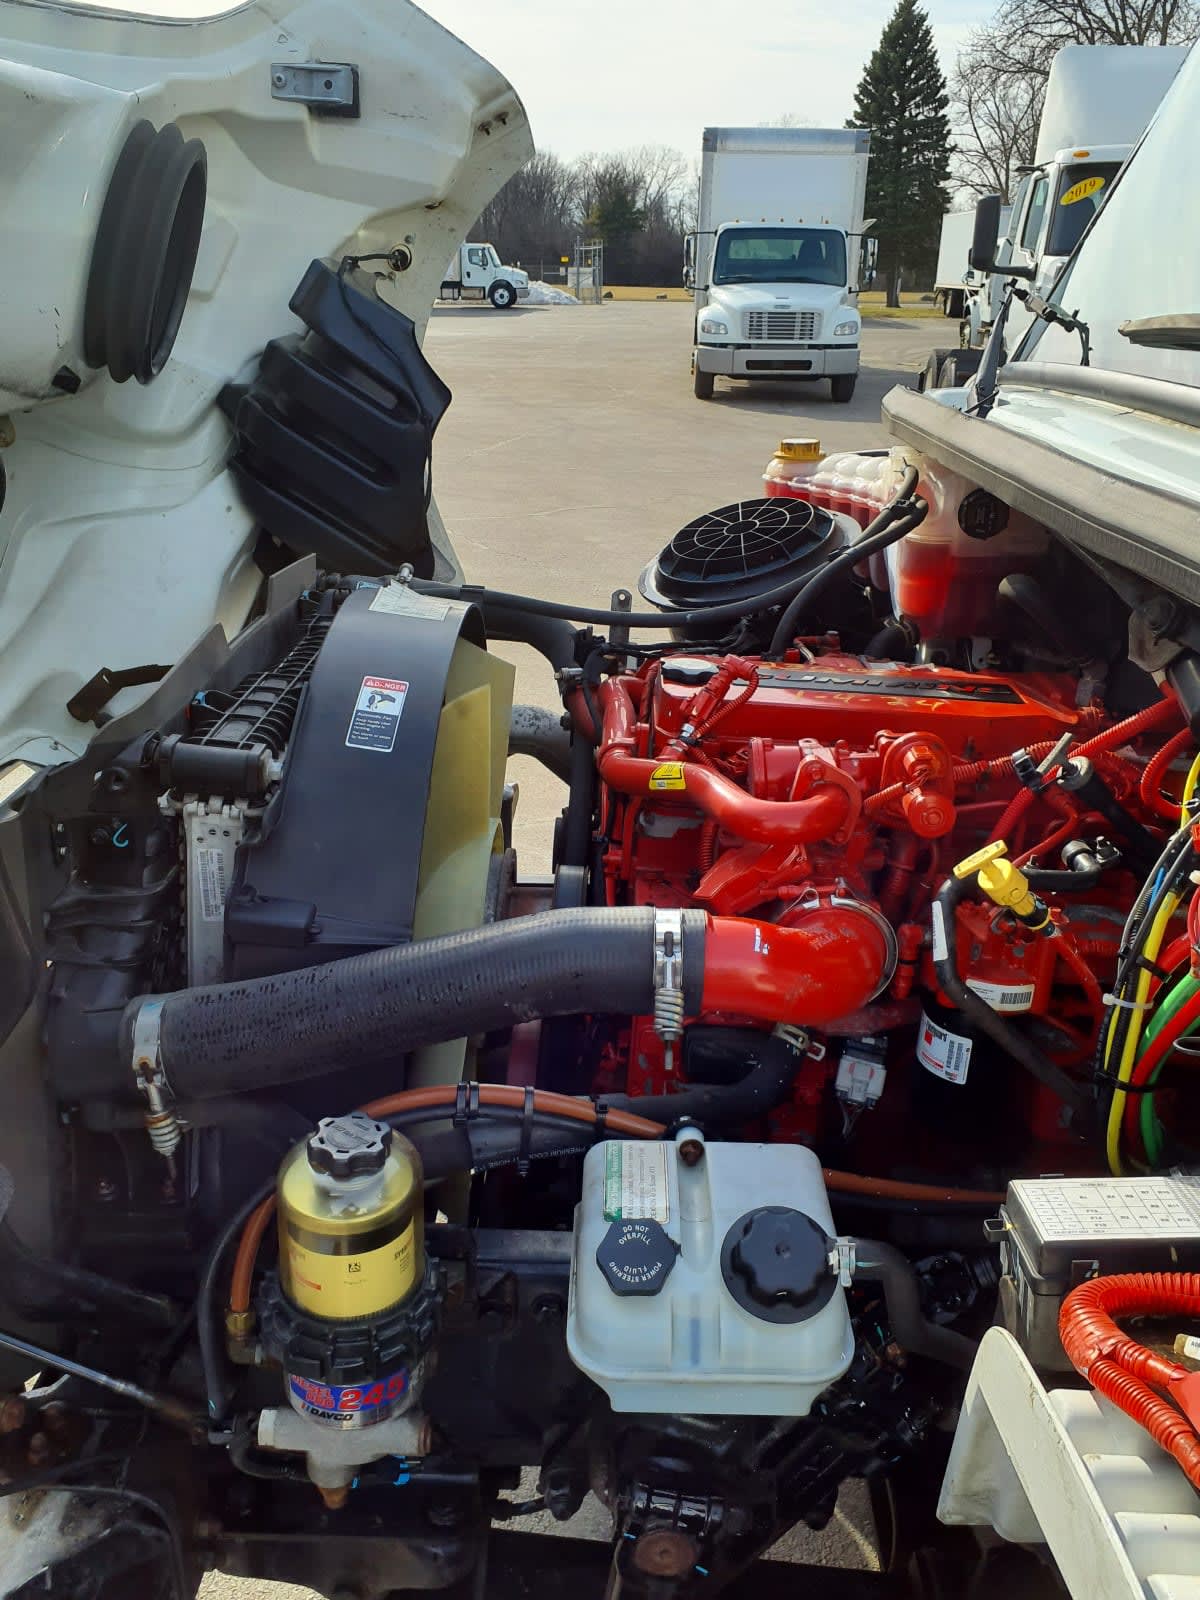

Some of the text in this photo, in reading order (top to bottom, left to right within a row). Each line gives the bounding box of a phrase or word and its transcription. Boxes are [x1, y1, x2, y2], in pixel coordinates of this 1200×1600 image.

[1068, 179, 1096, 201] 2019
[374, 681, 406, 692] DANGER
[623, 1224, 650, 1233] DO NOT
[618, 1232, 652, 1245] OVERFILL
[609, 1261, 663, 1283] POWER STEERING
[623, 1265, 648, 1274] FLUID
